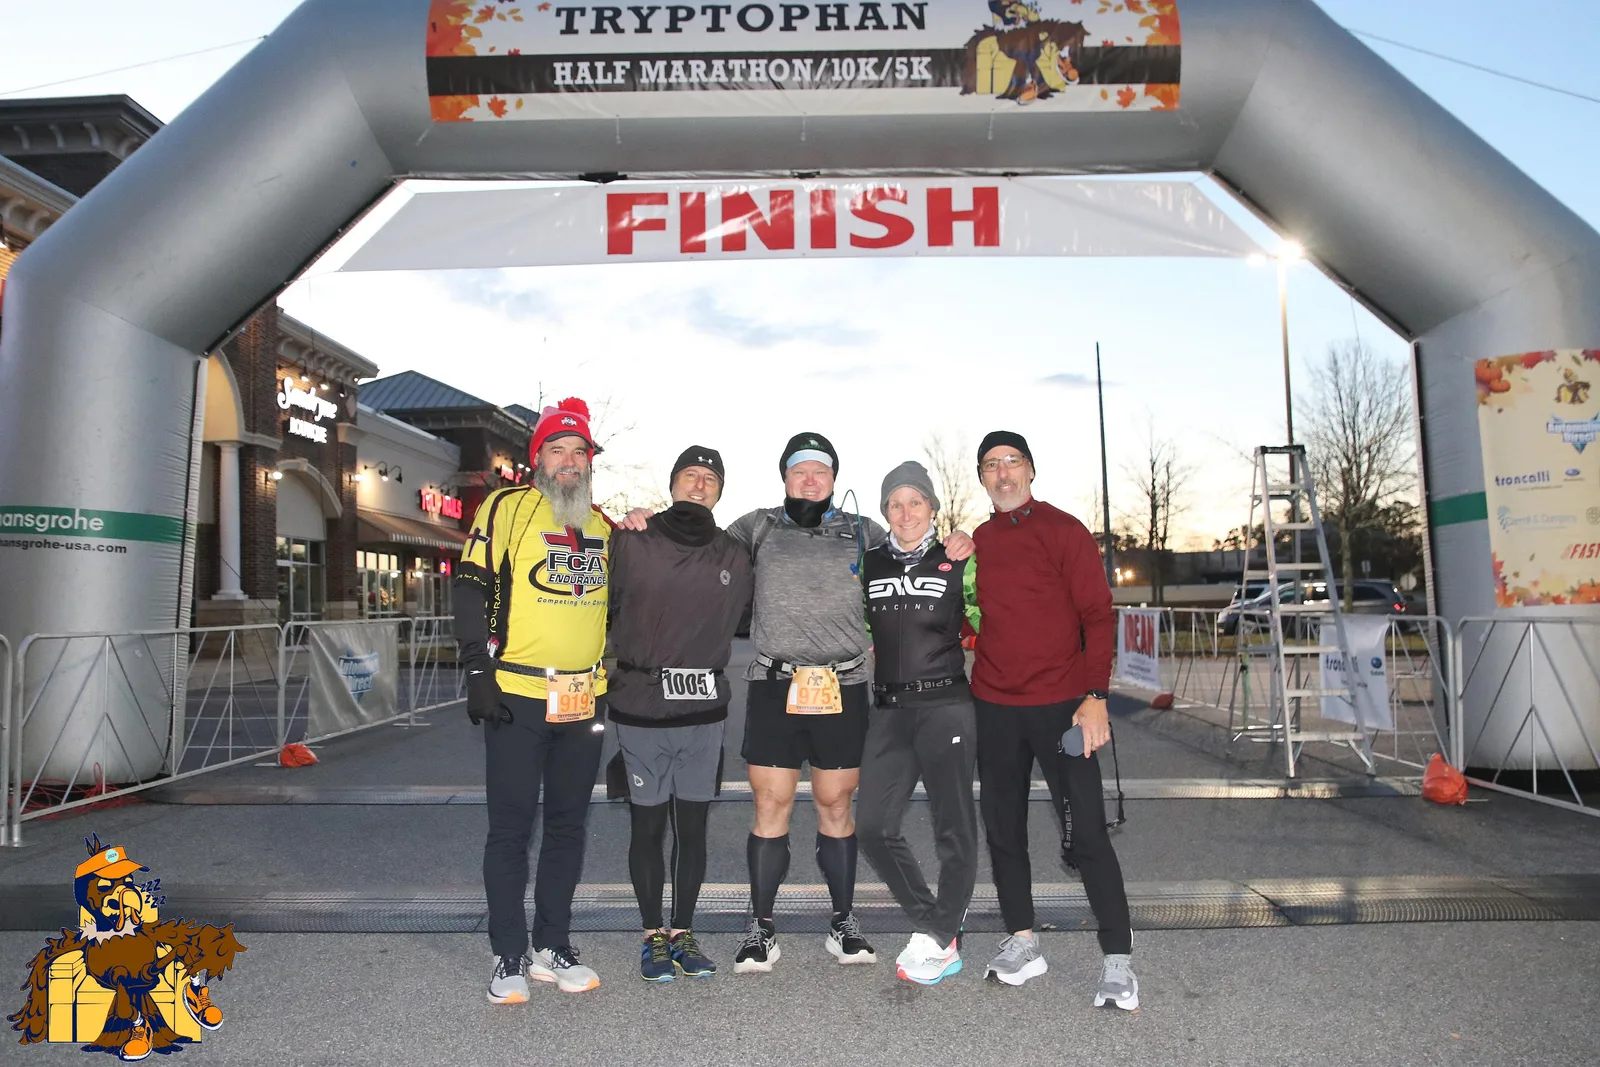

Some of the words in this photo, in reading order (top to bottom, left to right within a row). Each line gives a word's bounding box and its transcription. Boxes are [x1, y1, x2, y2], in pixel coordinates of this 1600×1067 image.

[555, 2, 928, 35] TRYPTOPHAN
[553, 61, 630, 85] HALF
[639, 57, 932, 84] MARATHON/10K/5K
[606, 187, 999, 255] FINISH
[1495, 471, 1550, 486] troncalli
[547, 550, 604, 574] FCA
[549, 573, 606, 585] ENDURANCE
[537, 597, 578, 607] Competing
[872, 603, 935, 612] RACING
[664, 672, 709, 696] 1005
[560, 692, 589, 713] 919
[799, 687, 832, 705] 975
[1063, 796, 1073, 849] SPIBELT
